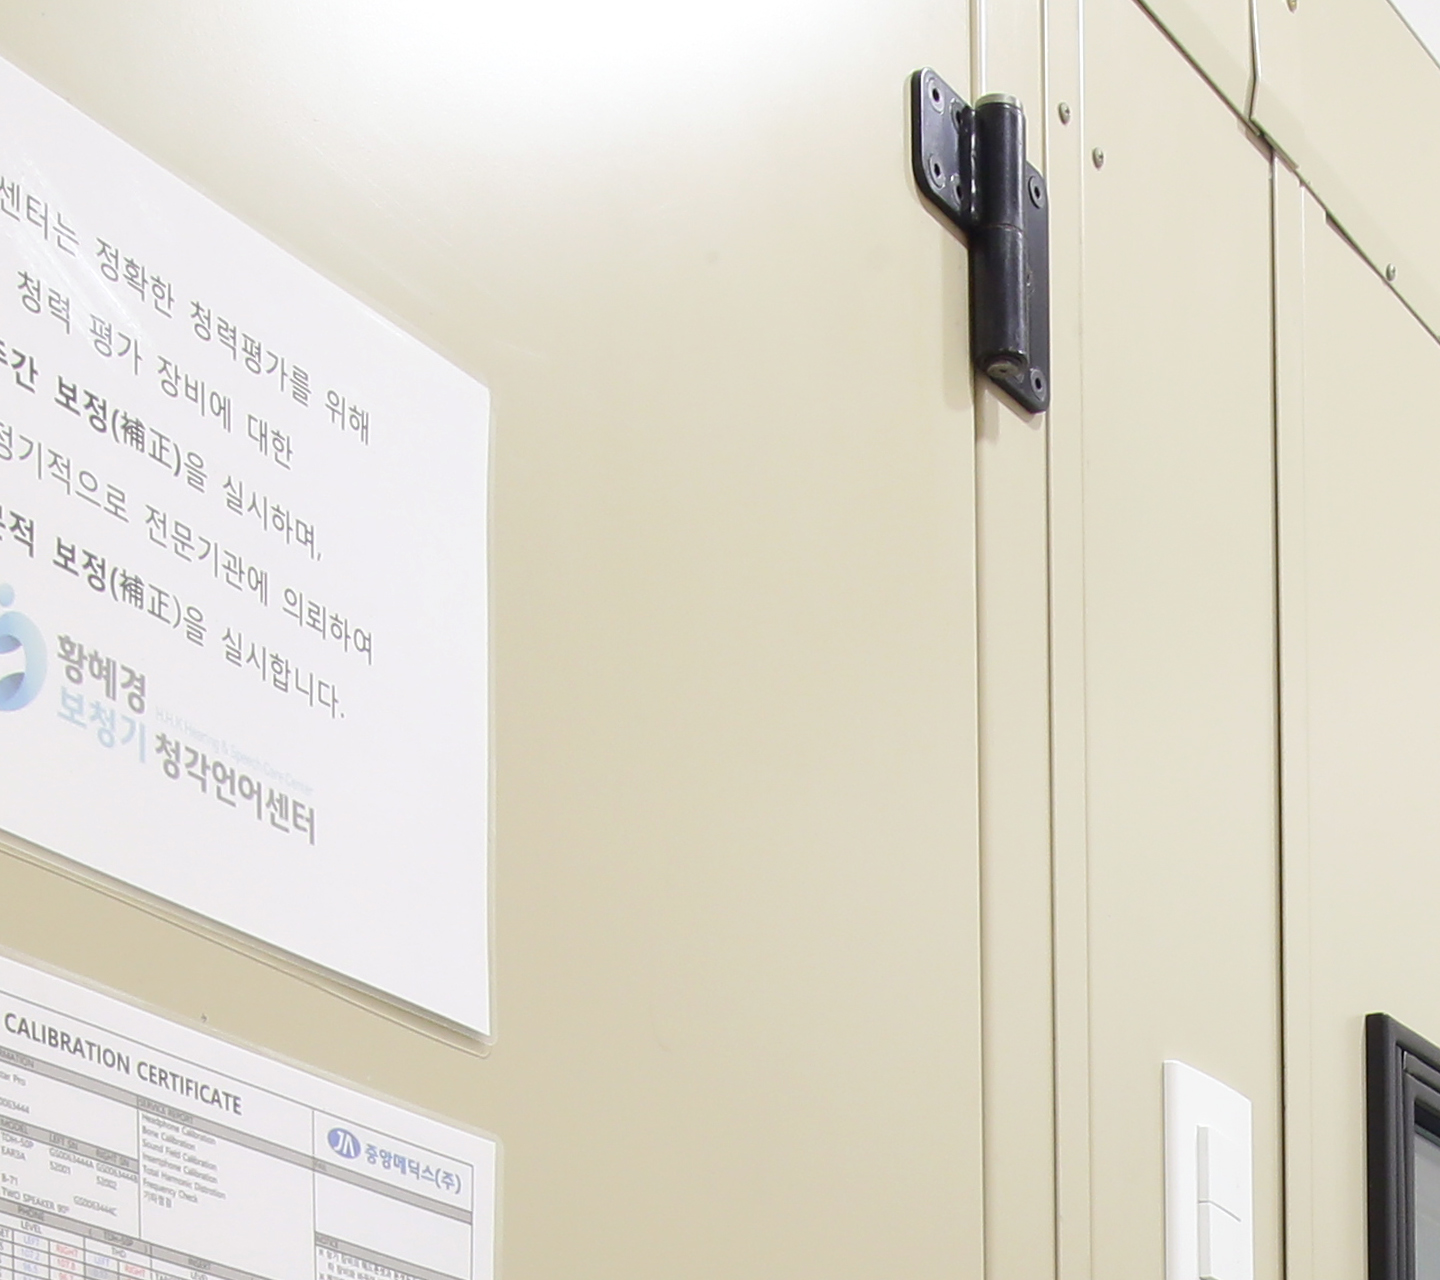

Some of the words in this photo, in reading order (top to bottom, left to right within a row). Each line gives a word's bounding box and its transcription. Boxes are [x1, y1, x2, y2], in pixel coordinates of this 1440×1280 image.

[17, 270, 70, 334] 청력
[89, 313, 143, 376] 평가
[157, 355, 231, 433] 장비에
[247, 414, 293, 470] 대한
[96, 237, 175, 318] 정확한
[190, 301, 312, 407] 청력평가를
[325, 389, 369, 446] 위해
[54, 375, 207, 493] 보정(補正)을
[222, 475, 322, 562] 실시하며,
[53, 537, 207, 647] 보정(補正)을
[221, 627, 345, 719] 실시합니다.
[145, 504, 268, 607] 전문기관에
[282, 588, 372, 666] 의뢰하여
[57, 634, 146, 714] 황혜경
[57, 686, 146, 764] 보청기
[155, 732, 315, 846] 청각언어센터
[1, 1119, 29, 1134] MODEL
[4, 1013, 131, 1075] CALIBRATION
[137, 1060, 242, 1116] CERTIFICATE
[23, 1193, 55, 1211] SPEAKER
[364, 1143, 462, 1194] 중앙메딕스(주)
